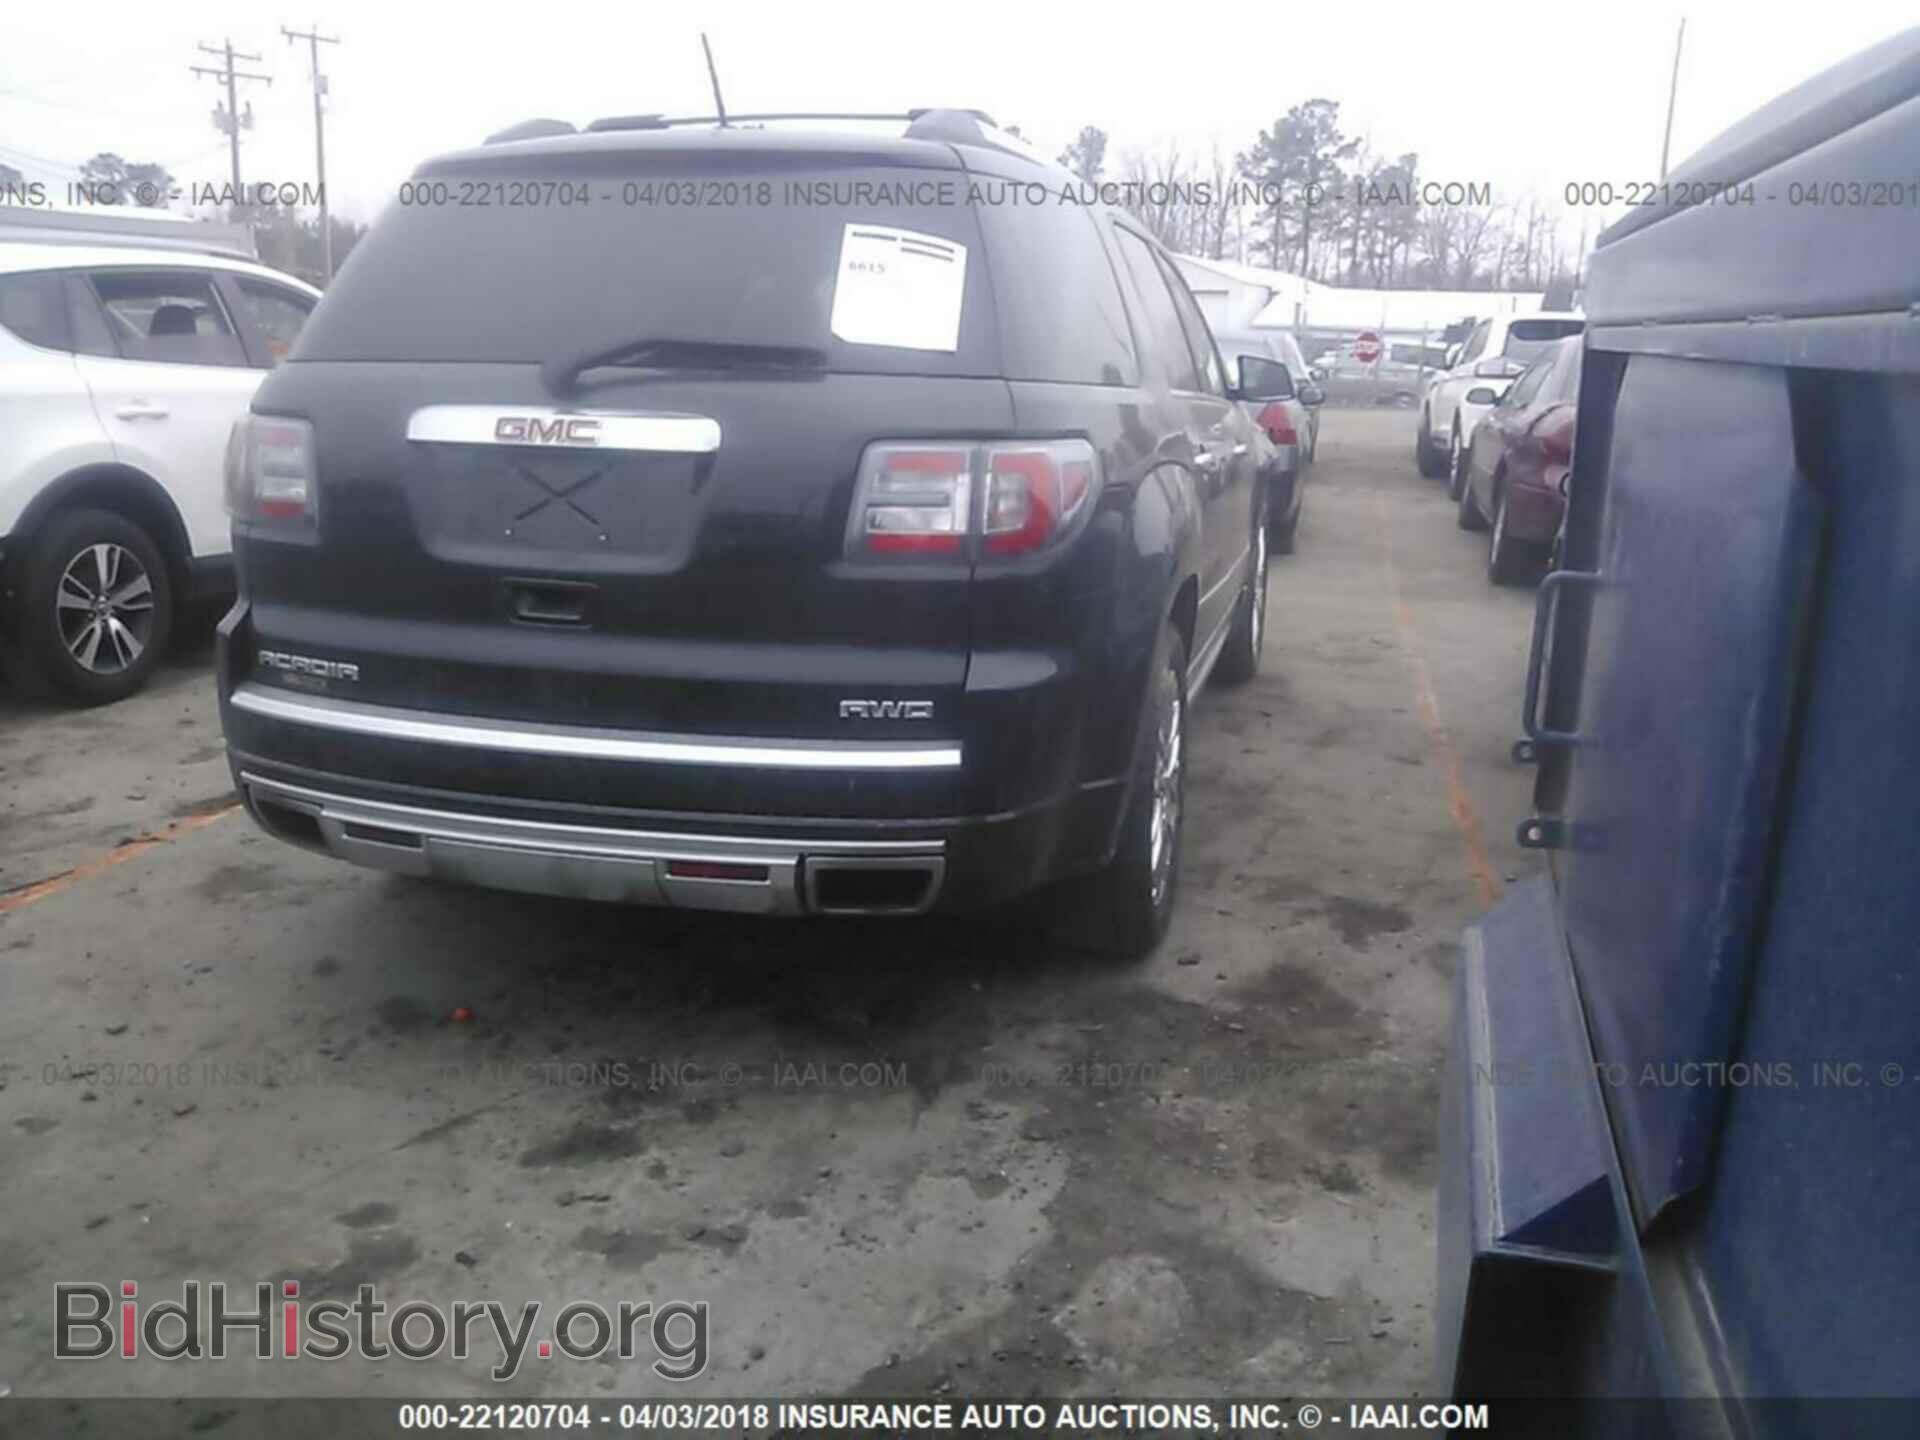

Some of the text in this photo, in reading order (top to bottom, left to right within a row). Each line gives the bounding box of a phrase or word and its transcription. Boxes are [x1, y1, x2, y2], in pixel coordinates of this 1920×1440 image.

[494, 416, 600, 444] GMC
[258, 650, 360, 681] ACADIA
[840, 699, 934, 719] AWD
